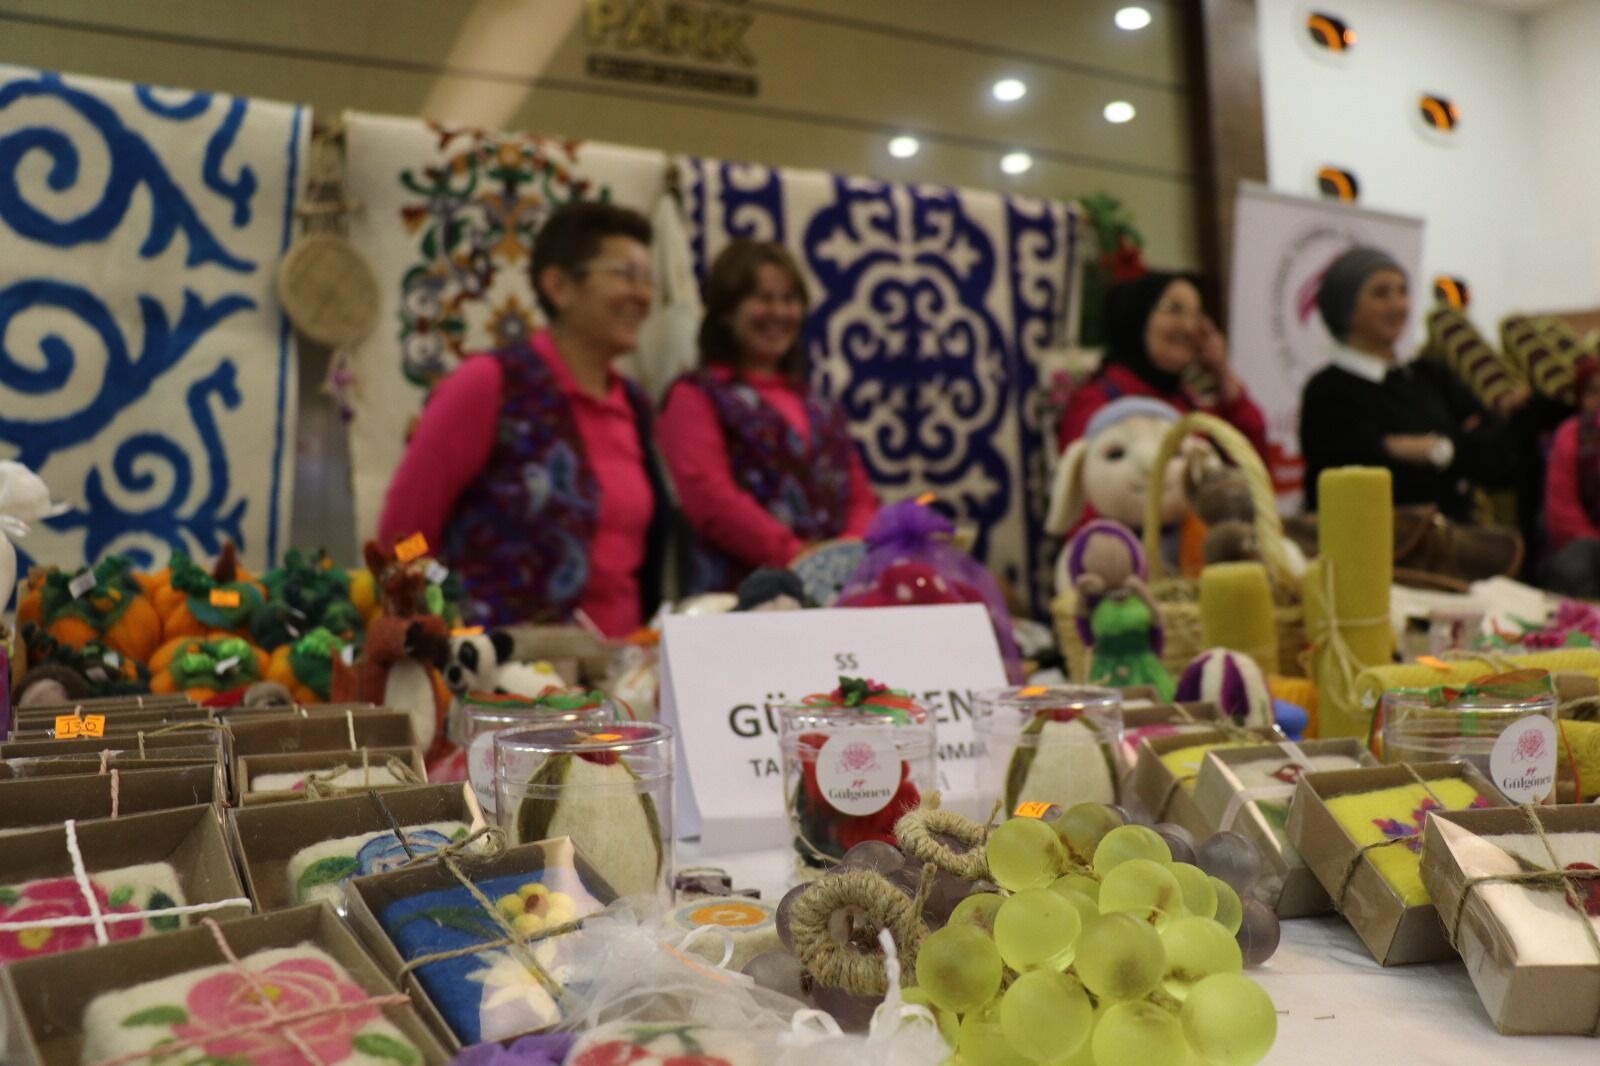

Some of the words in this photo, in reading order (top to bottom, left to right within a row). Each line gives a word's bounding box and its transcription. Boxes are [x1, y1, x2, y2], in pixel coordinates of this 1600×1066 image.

[583, 0, 759, 68] PARK
[833, 652, 859, 671] SS
[1503, 776, 1552, 791] Gülgönen
[828, 787, 890, 802] Gülgönen
